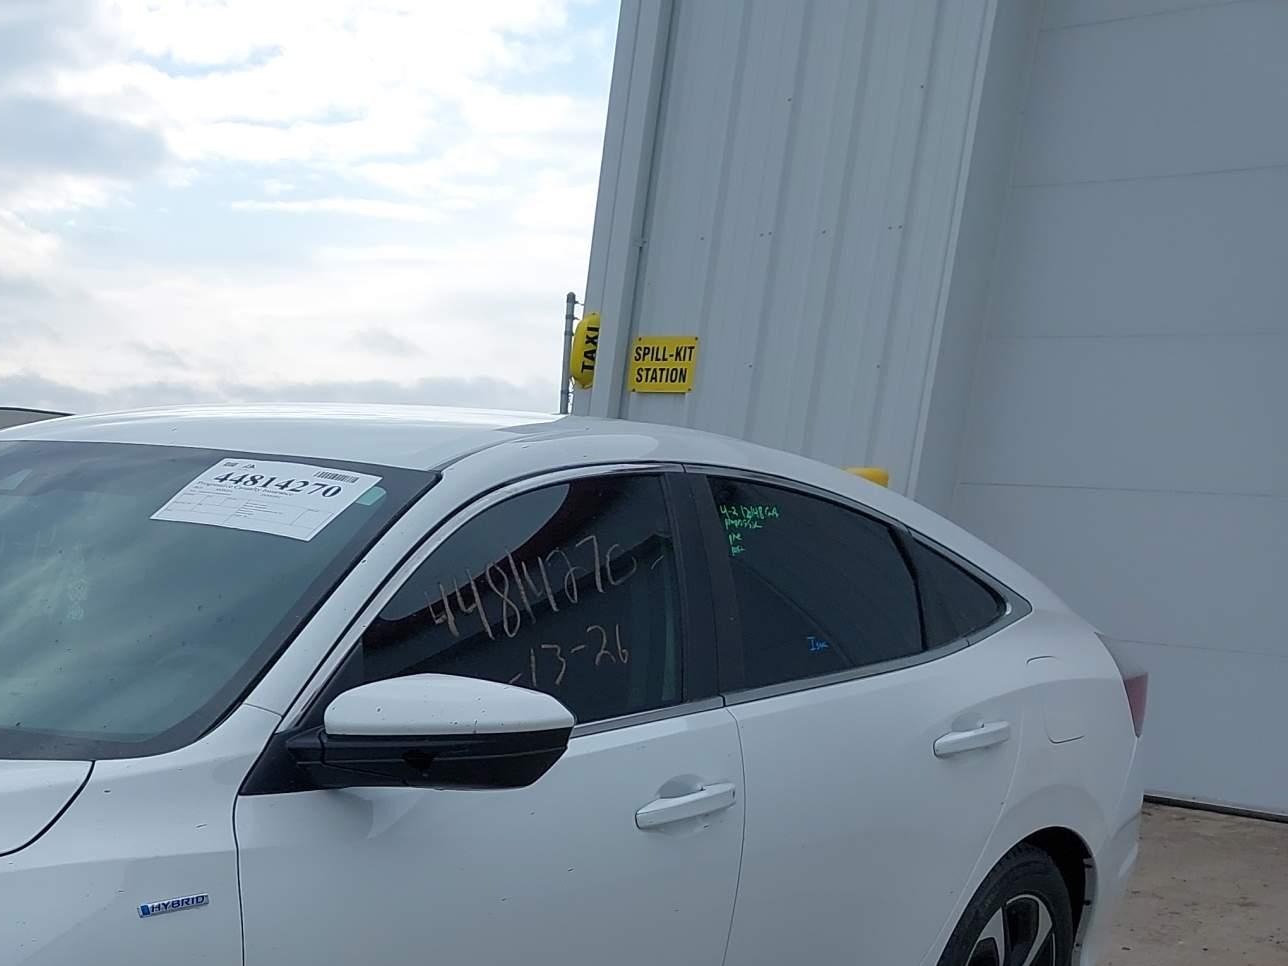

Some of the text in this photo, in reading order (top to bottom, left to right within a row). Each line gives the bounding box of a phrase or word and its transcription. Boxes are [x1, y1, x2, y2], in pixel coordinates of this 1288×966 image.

[634, 346, 696, 362] SPILL-KIT
[635, 367, 688, 383] STATION
[214, 471, 342, 498] 44814270
[151, 895, 206, 913] HYBRID
